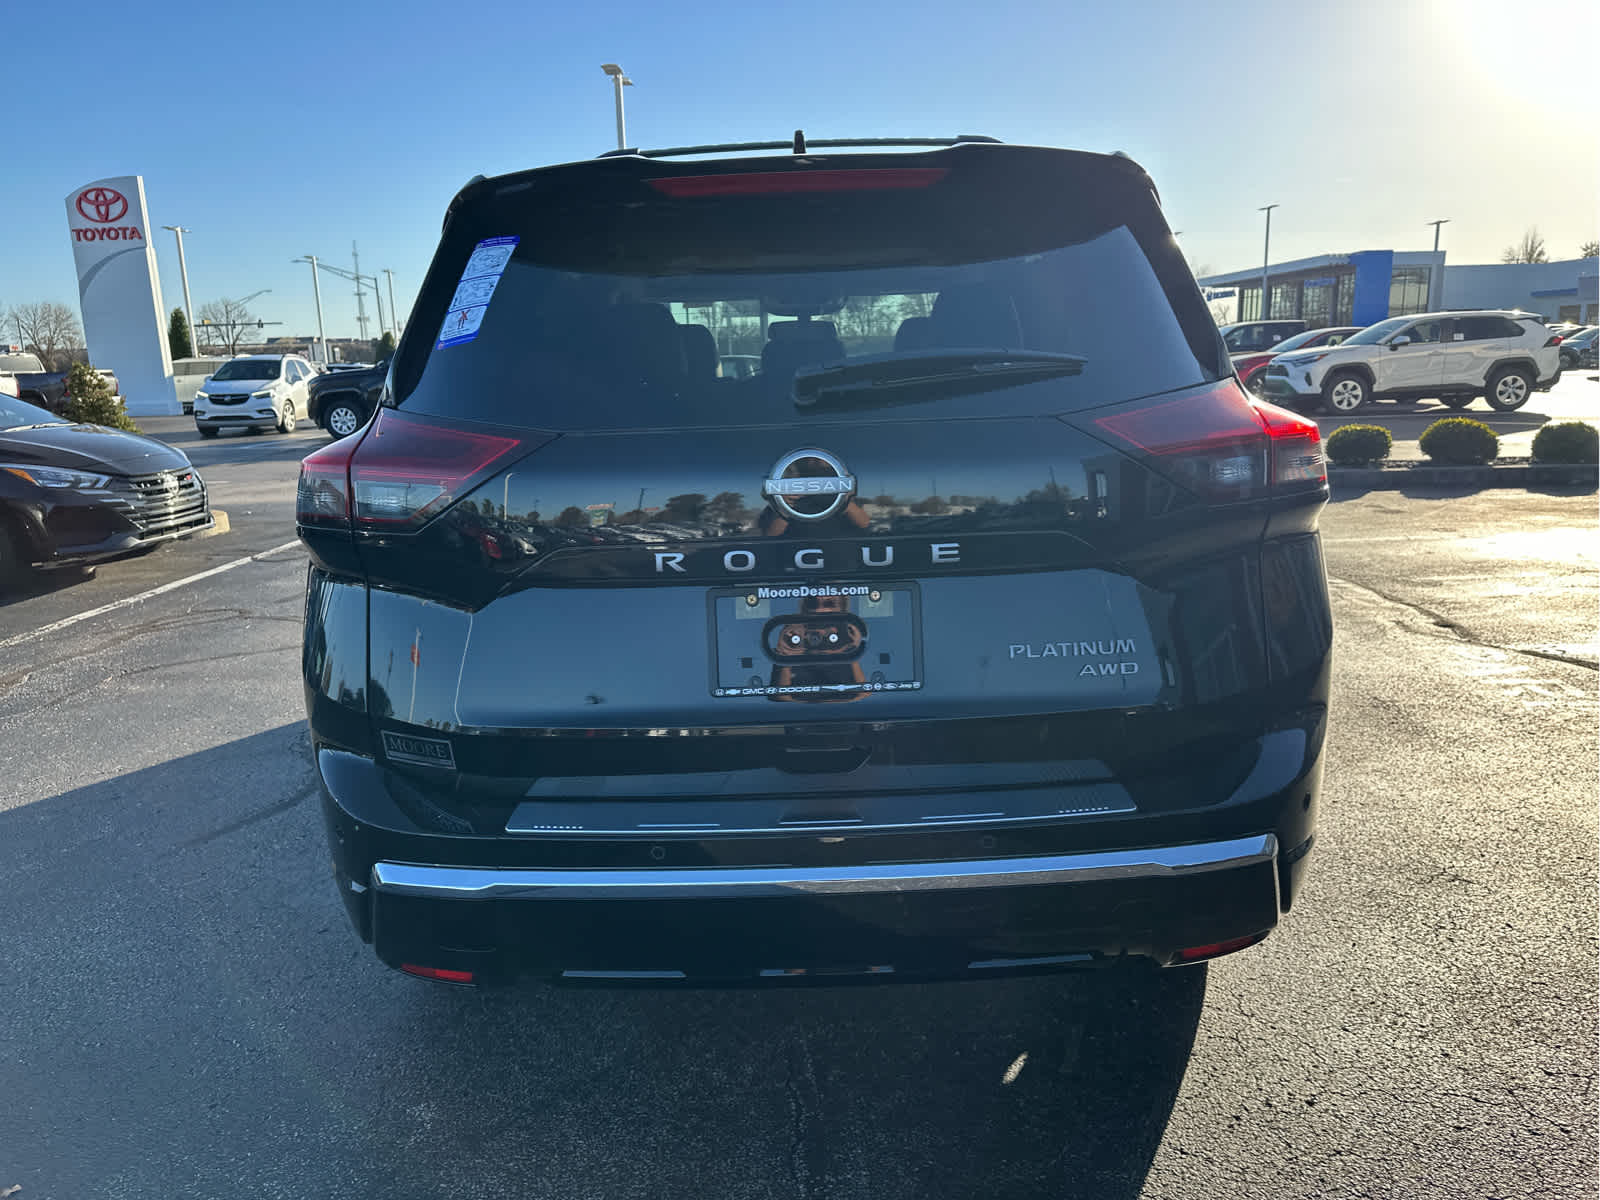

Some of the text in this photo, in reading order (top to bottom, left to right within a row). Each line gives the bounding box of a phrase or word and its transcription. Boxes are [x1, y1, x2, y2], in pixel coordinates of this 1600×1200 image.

[72, 227, 142, 241] TOYOTA
[766, 479, 853, 494] NISSAN
[655, 543, 961, 572] ROGUE
[757, 585, 870, 599] MooreDeals.com
[1008, 639, 1137, 659] PLATINUM
[1079, 662, 1139, 676] AWD
[742, 688, 764, 696] GMC
[389, 737, 448, 758] MOORE
